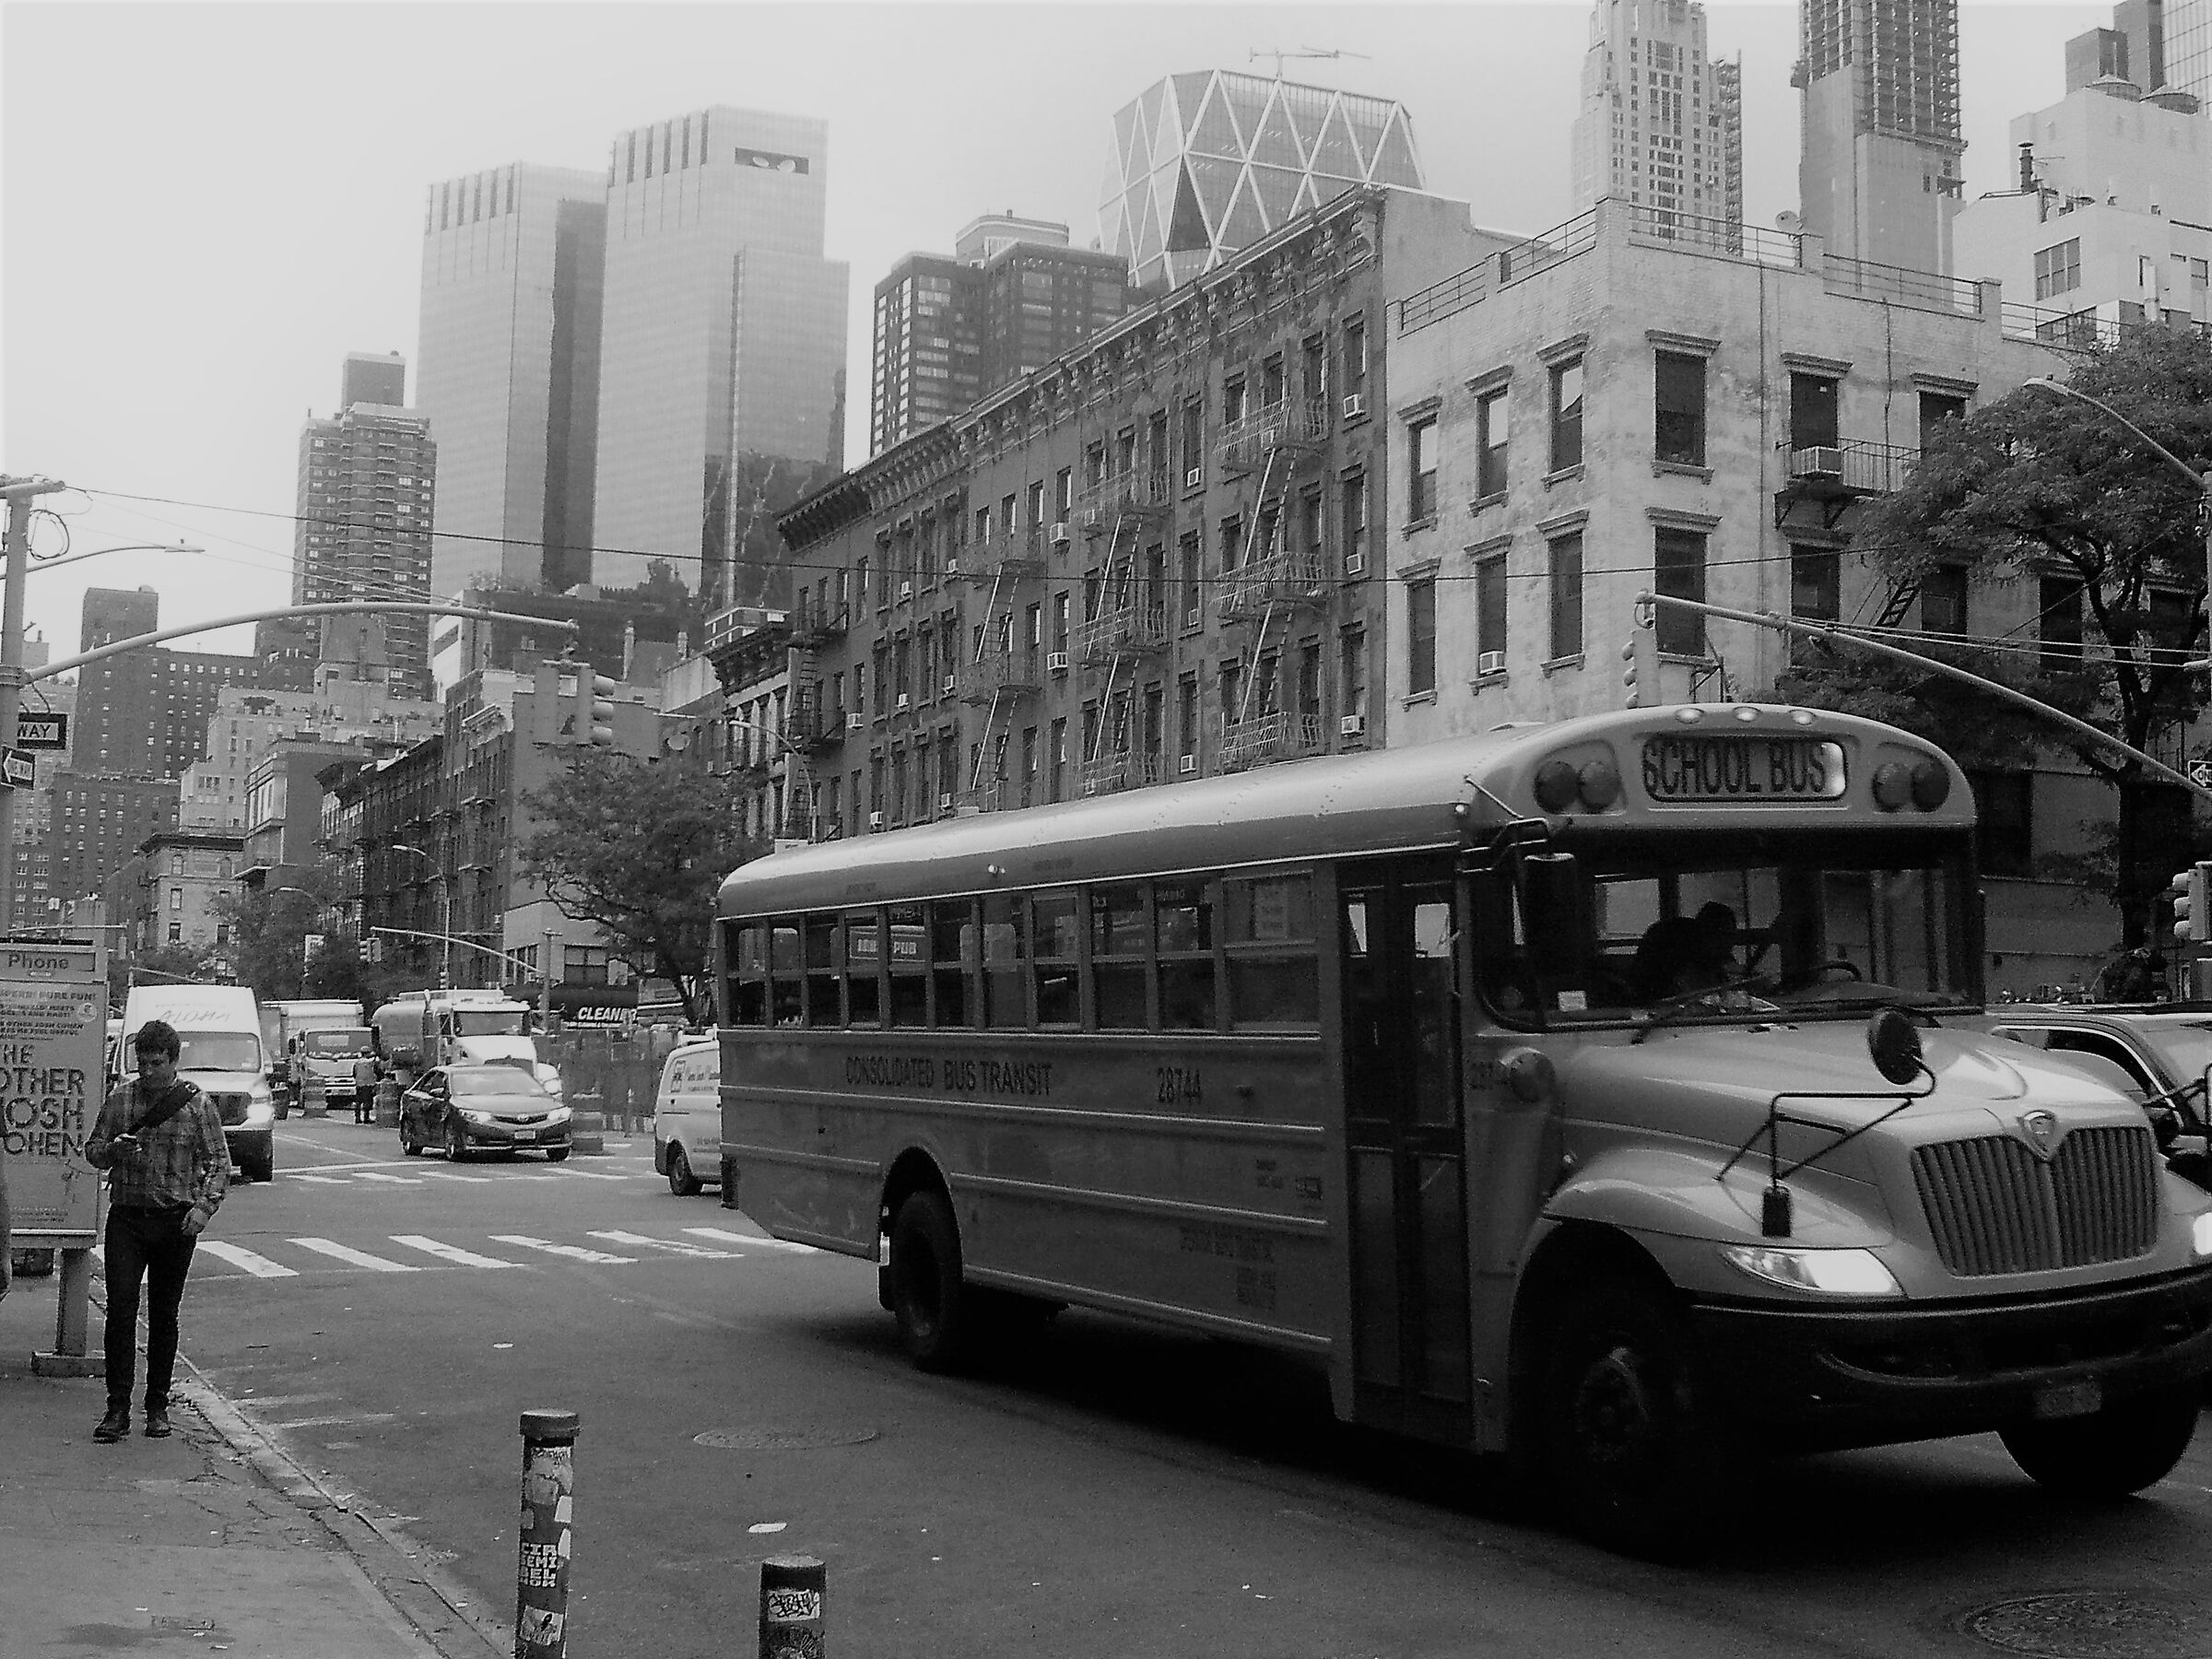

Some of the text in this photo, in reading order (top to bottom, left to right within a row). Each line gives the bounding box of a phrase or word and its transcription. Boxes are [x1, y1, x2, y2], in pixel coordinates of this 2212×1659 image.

[1642, 739, 1826, 794] SCHOOL BUS
[8, 953, 69, 970] Phone
[3, 1043, 34, 1065] HE
[846, 1056, 1053, 1097] CONSOLIDATED BUS TRANSIT
[1158, 1066, 1202, 1104] 28744
[0, 1132, 83, 1158] OHEN
